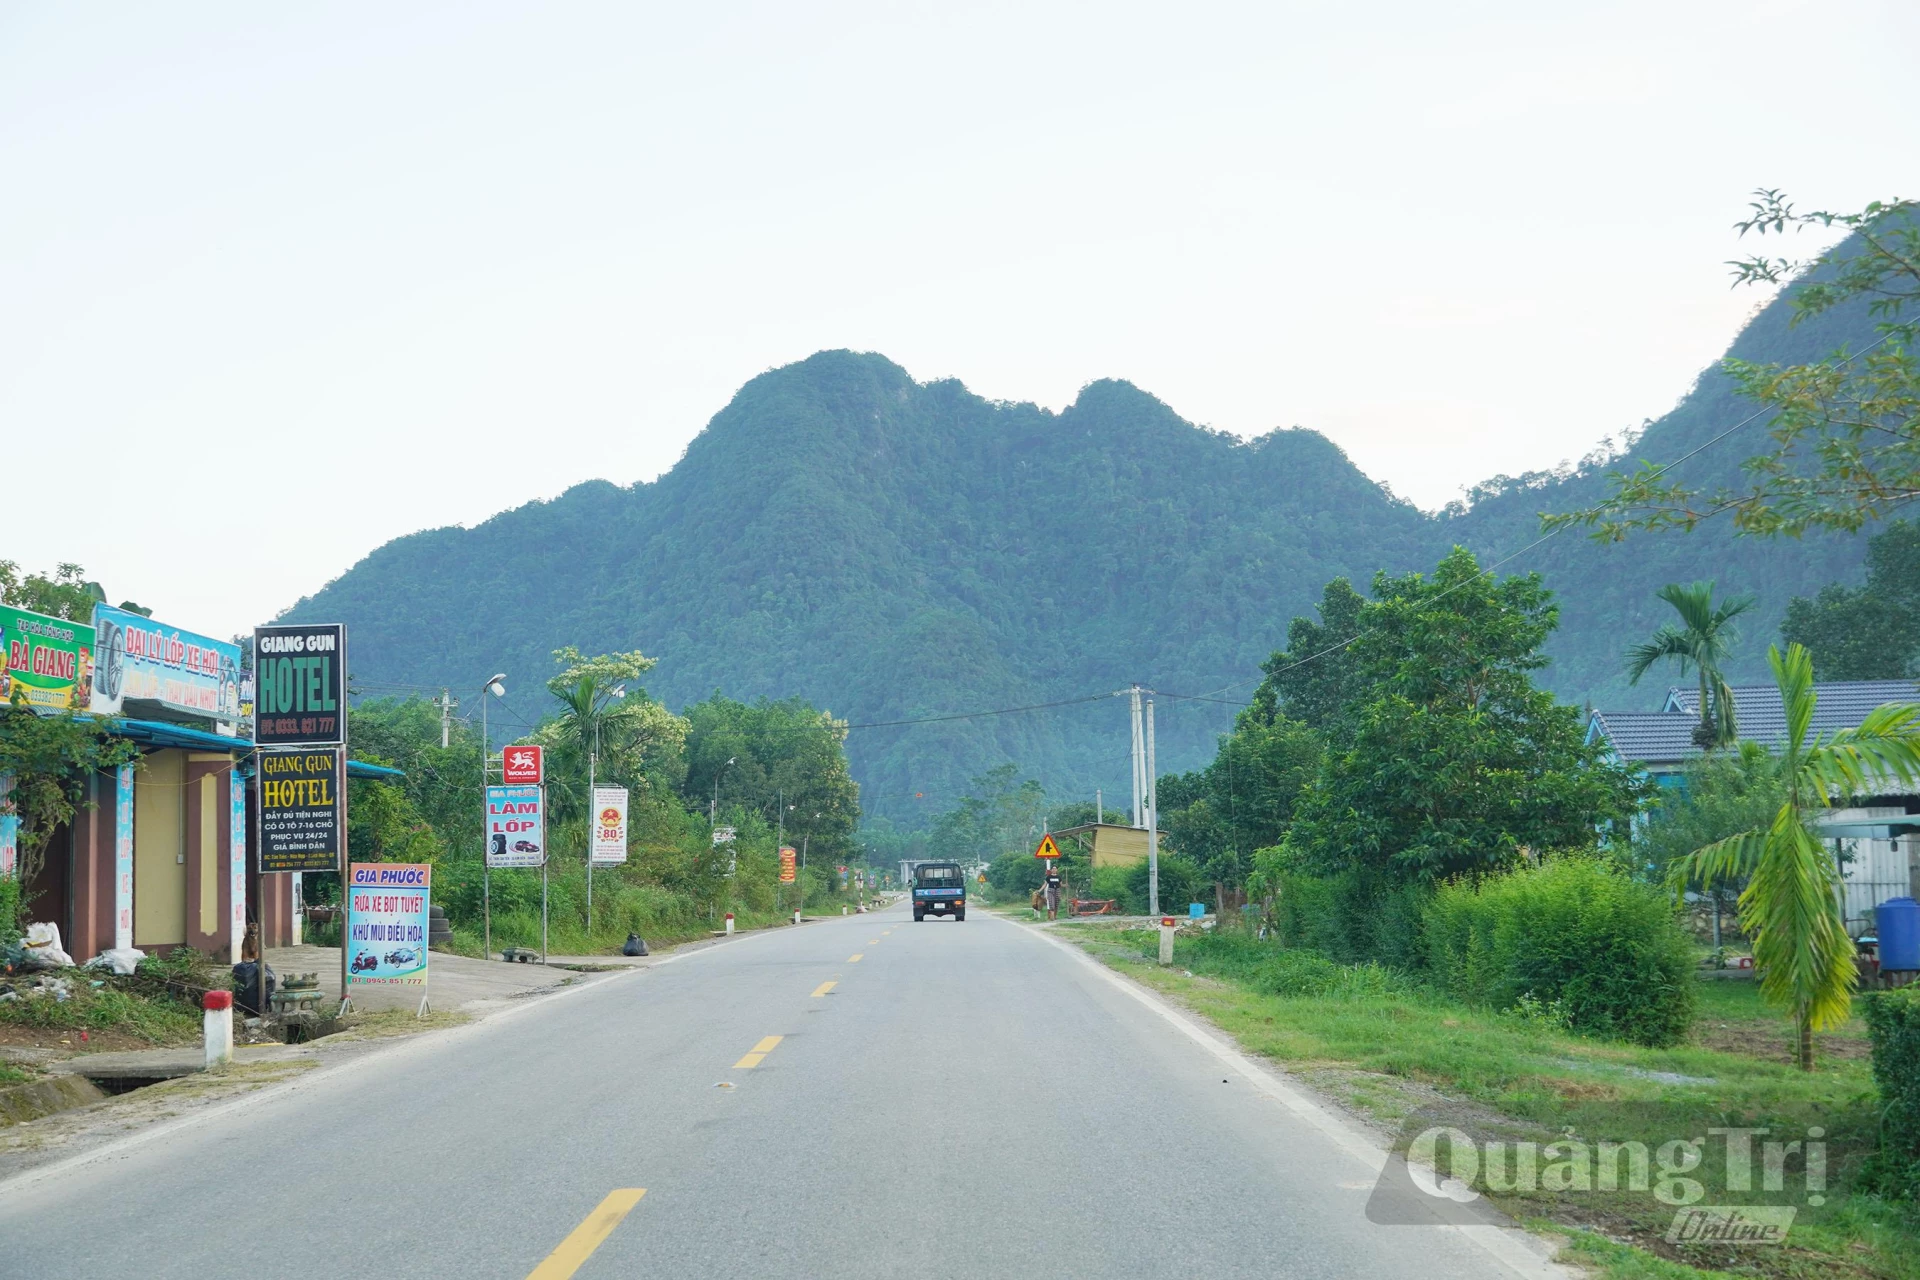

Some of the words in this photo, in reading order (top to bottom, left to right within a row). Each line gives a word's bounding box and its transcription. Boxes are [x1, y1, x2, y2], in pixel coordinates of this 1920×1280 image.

[126, 625, 146, 664] ĐẠI
[148, 629, 163, 664] LÝ
[164, 631, 185, 668] LỐP
[187, 643, 201, 673] XE
[202, 646, 220, 678] HƠI
[260, 636, 304, 653] GIANG
[306, 635, 335, 651] GUN
[10, 635, 30, 673] BÀ
[33, 645, 75, 680] GIANG
[260, 656, 336, 713] HOTEL
[319, 717, 335, 732] 777
[263, 756, 302, 776] GIANG
[305, 755, 332, 774] GUN
[263, 779, 334, 808] HOTEL
[283, 810, 294, 819] ĐỦ
[312, 811, 332, 819] NGHI
[490, 801, 538, 815] LÀM
[264, 820, 278, 831] CÓ
[287, 819, 297, 829] TÔ
[298, 821, 314, 830] 7-16
[492, 818, 535, 833] LỐP
[270, 833, 292, 842] PHỤC
[306, 831, 328, 840] 24/24
[603, 829, 617, 839] 80
[273, 842, 288, 851] GIÁ
[289, 841, 307, 850] BÌNH
[308, 841, 325, 850] DÂN
[355, 869, 377, 882] GIA
[380, 867, 424, 883] PHƯỚC
[354, 890, 370, 912] RỬA
[372, 896, 381, 912] XE
[384, 896, 398, 916] BỌT
[401, 893, 424, 913] TUYẾT
[352, 919, 369, 940] KHỬ
[370, 921, 385, 940] MÙI
[407, 922, 423, 941] HÒA
